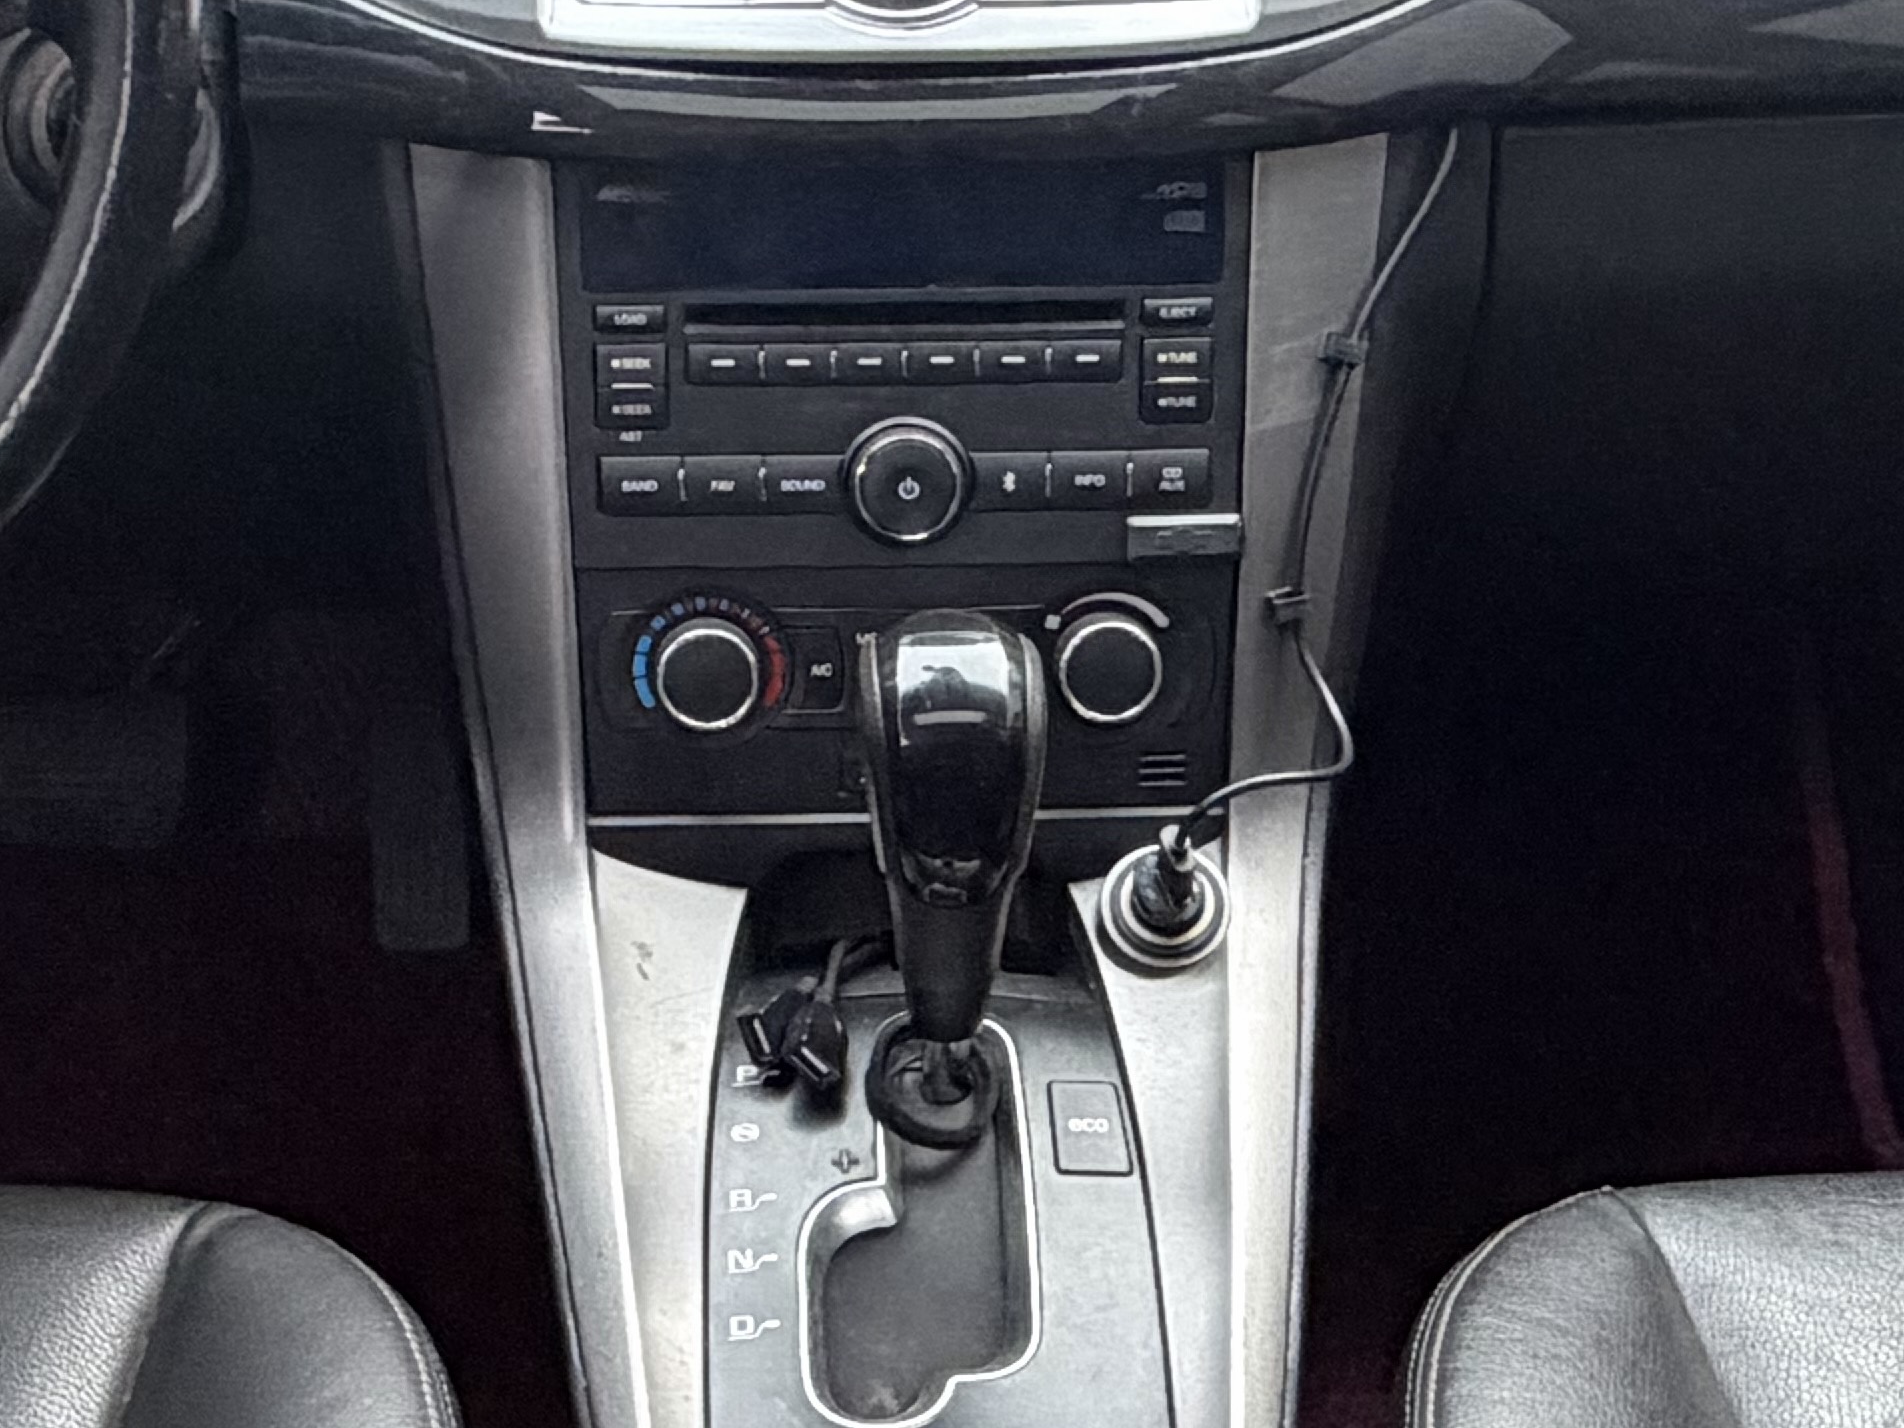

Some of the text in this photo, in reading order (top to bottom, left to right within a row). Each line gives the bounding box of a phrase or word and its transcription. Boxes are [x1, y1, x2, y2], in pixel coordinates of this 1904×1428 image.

[620, 479, 659, 493] BAND
[727, 1249, 754, 1269] N
[729, 1315, 755, 1336] D
